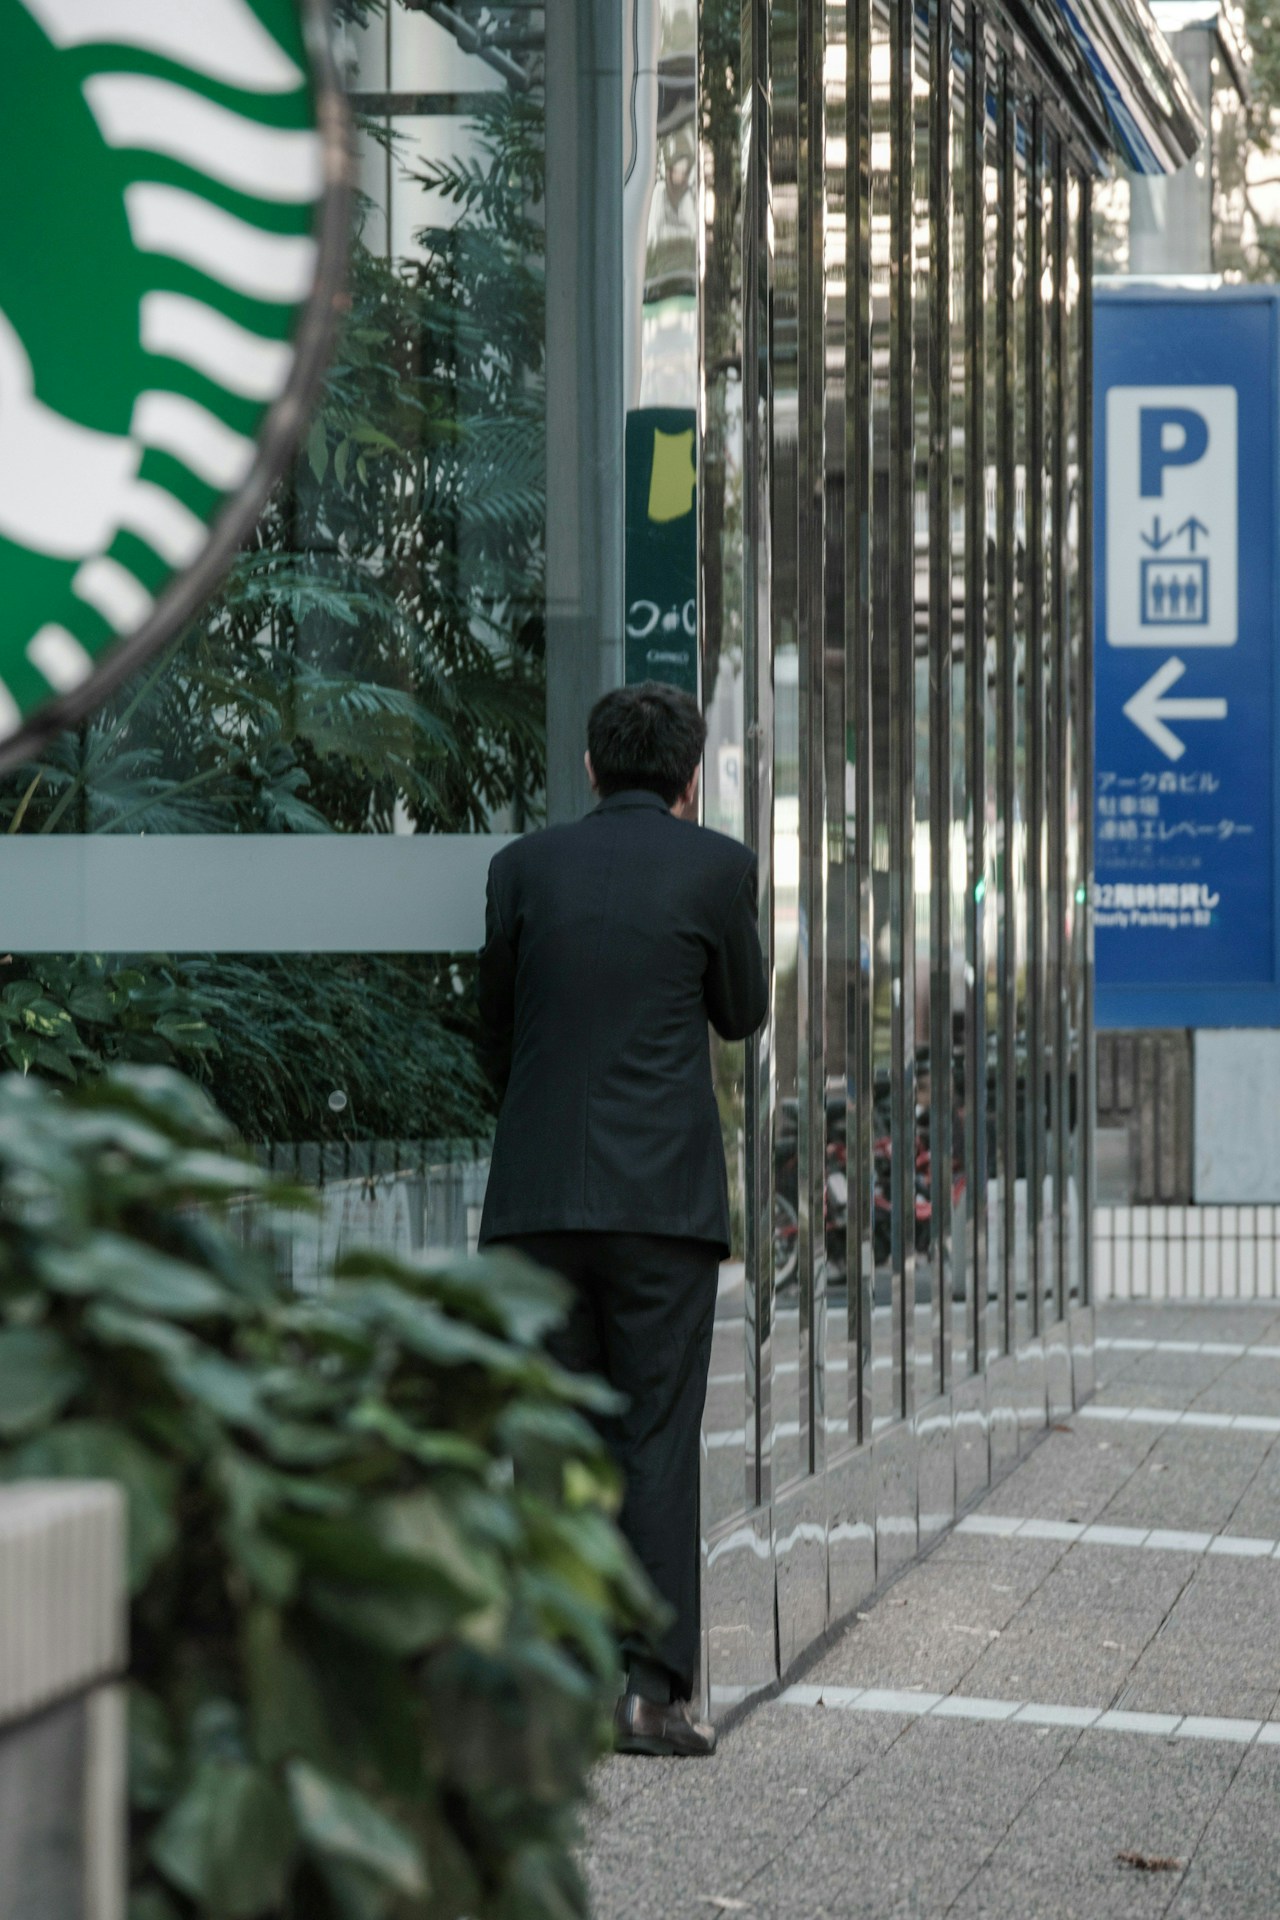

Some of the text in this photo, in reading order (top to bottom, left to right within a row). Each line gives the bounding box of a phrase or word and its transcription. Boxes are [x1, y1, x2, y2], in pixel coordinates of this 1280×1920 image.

[1140, 406, 1209, 498] P
[1098, 771, 1220, 793] アーク森ビル
